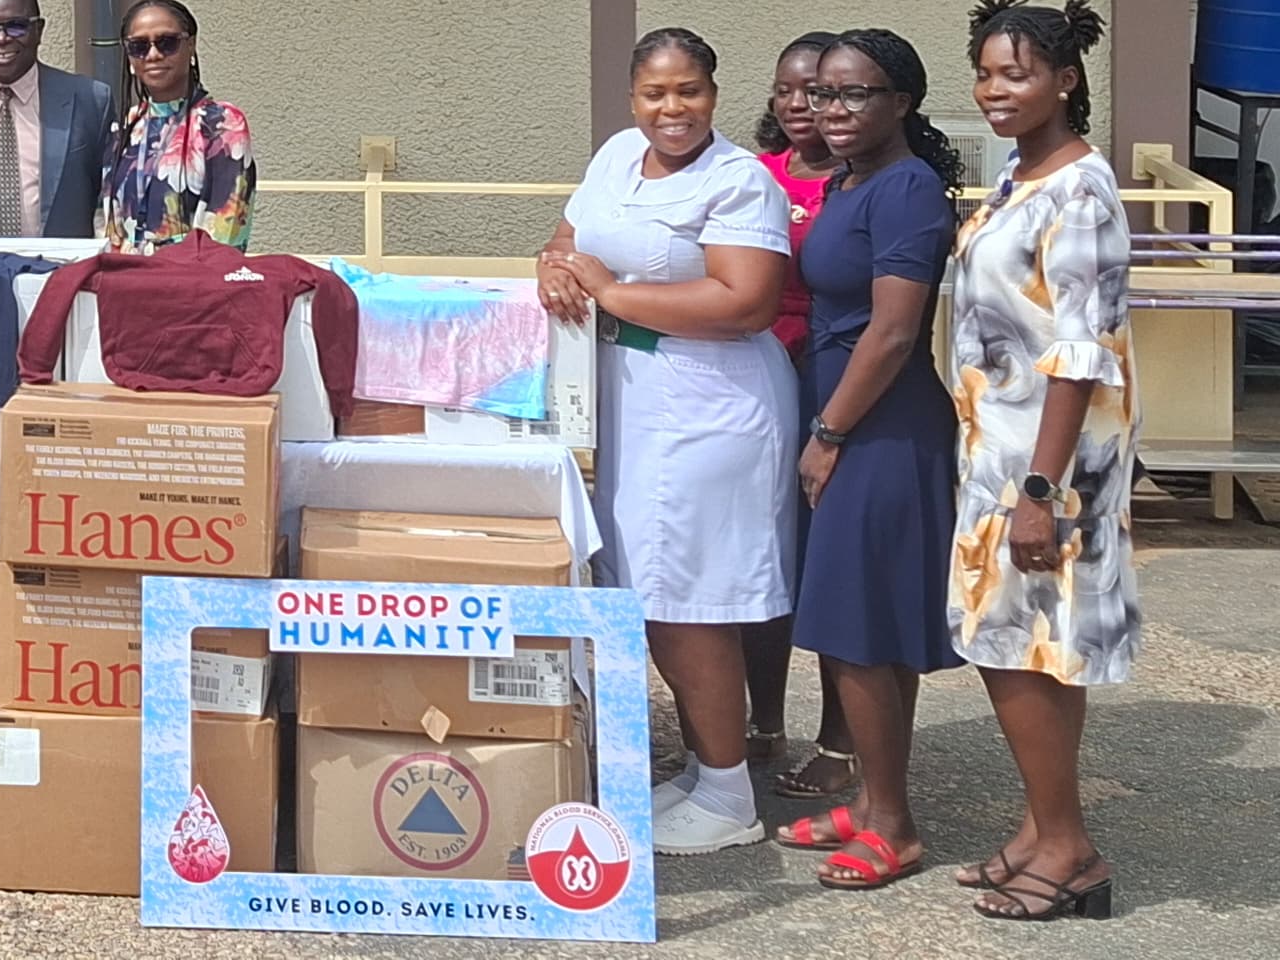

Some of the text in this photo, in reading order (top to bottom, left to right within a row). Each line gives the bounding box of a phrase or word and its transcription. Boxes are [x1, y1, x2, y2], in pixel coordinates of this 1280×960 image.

[190, 425, 205, 437] THE
[139, 492, 157, 501] MAKE
[159, 492, 165, 501] IT
[191, 494, 209, 504] MAKE
[211, 495, 217, 504] IT
[278, 592, 501, 619] ONE DROP OF
[279, 621, 503, 650] HUMANITY
[14, 640, 142, 709] Han
[390, 764, 470, 801] DELTA
[530, 815, 554, 852] NATIONAL
[554, 806, 581, 817] BLOOD
[435, 837, 467, 860] 1903
[249, 897, 535, 921] GIVE BLOOD. SAVE LIVES.
